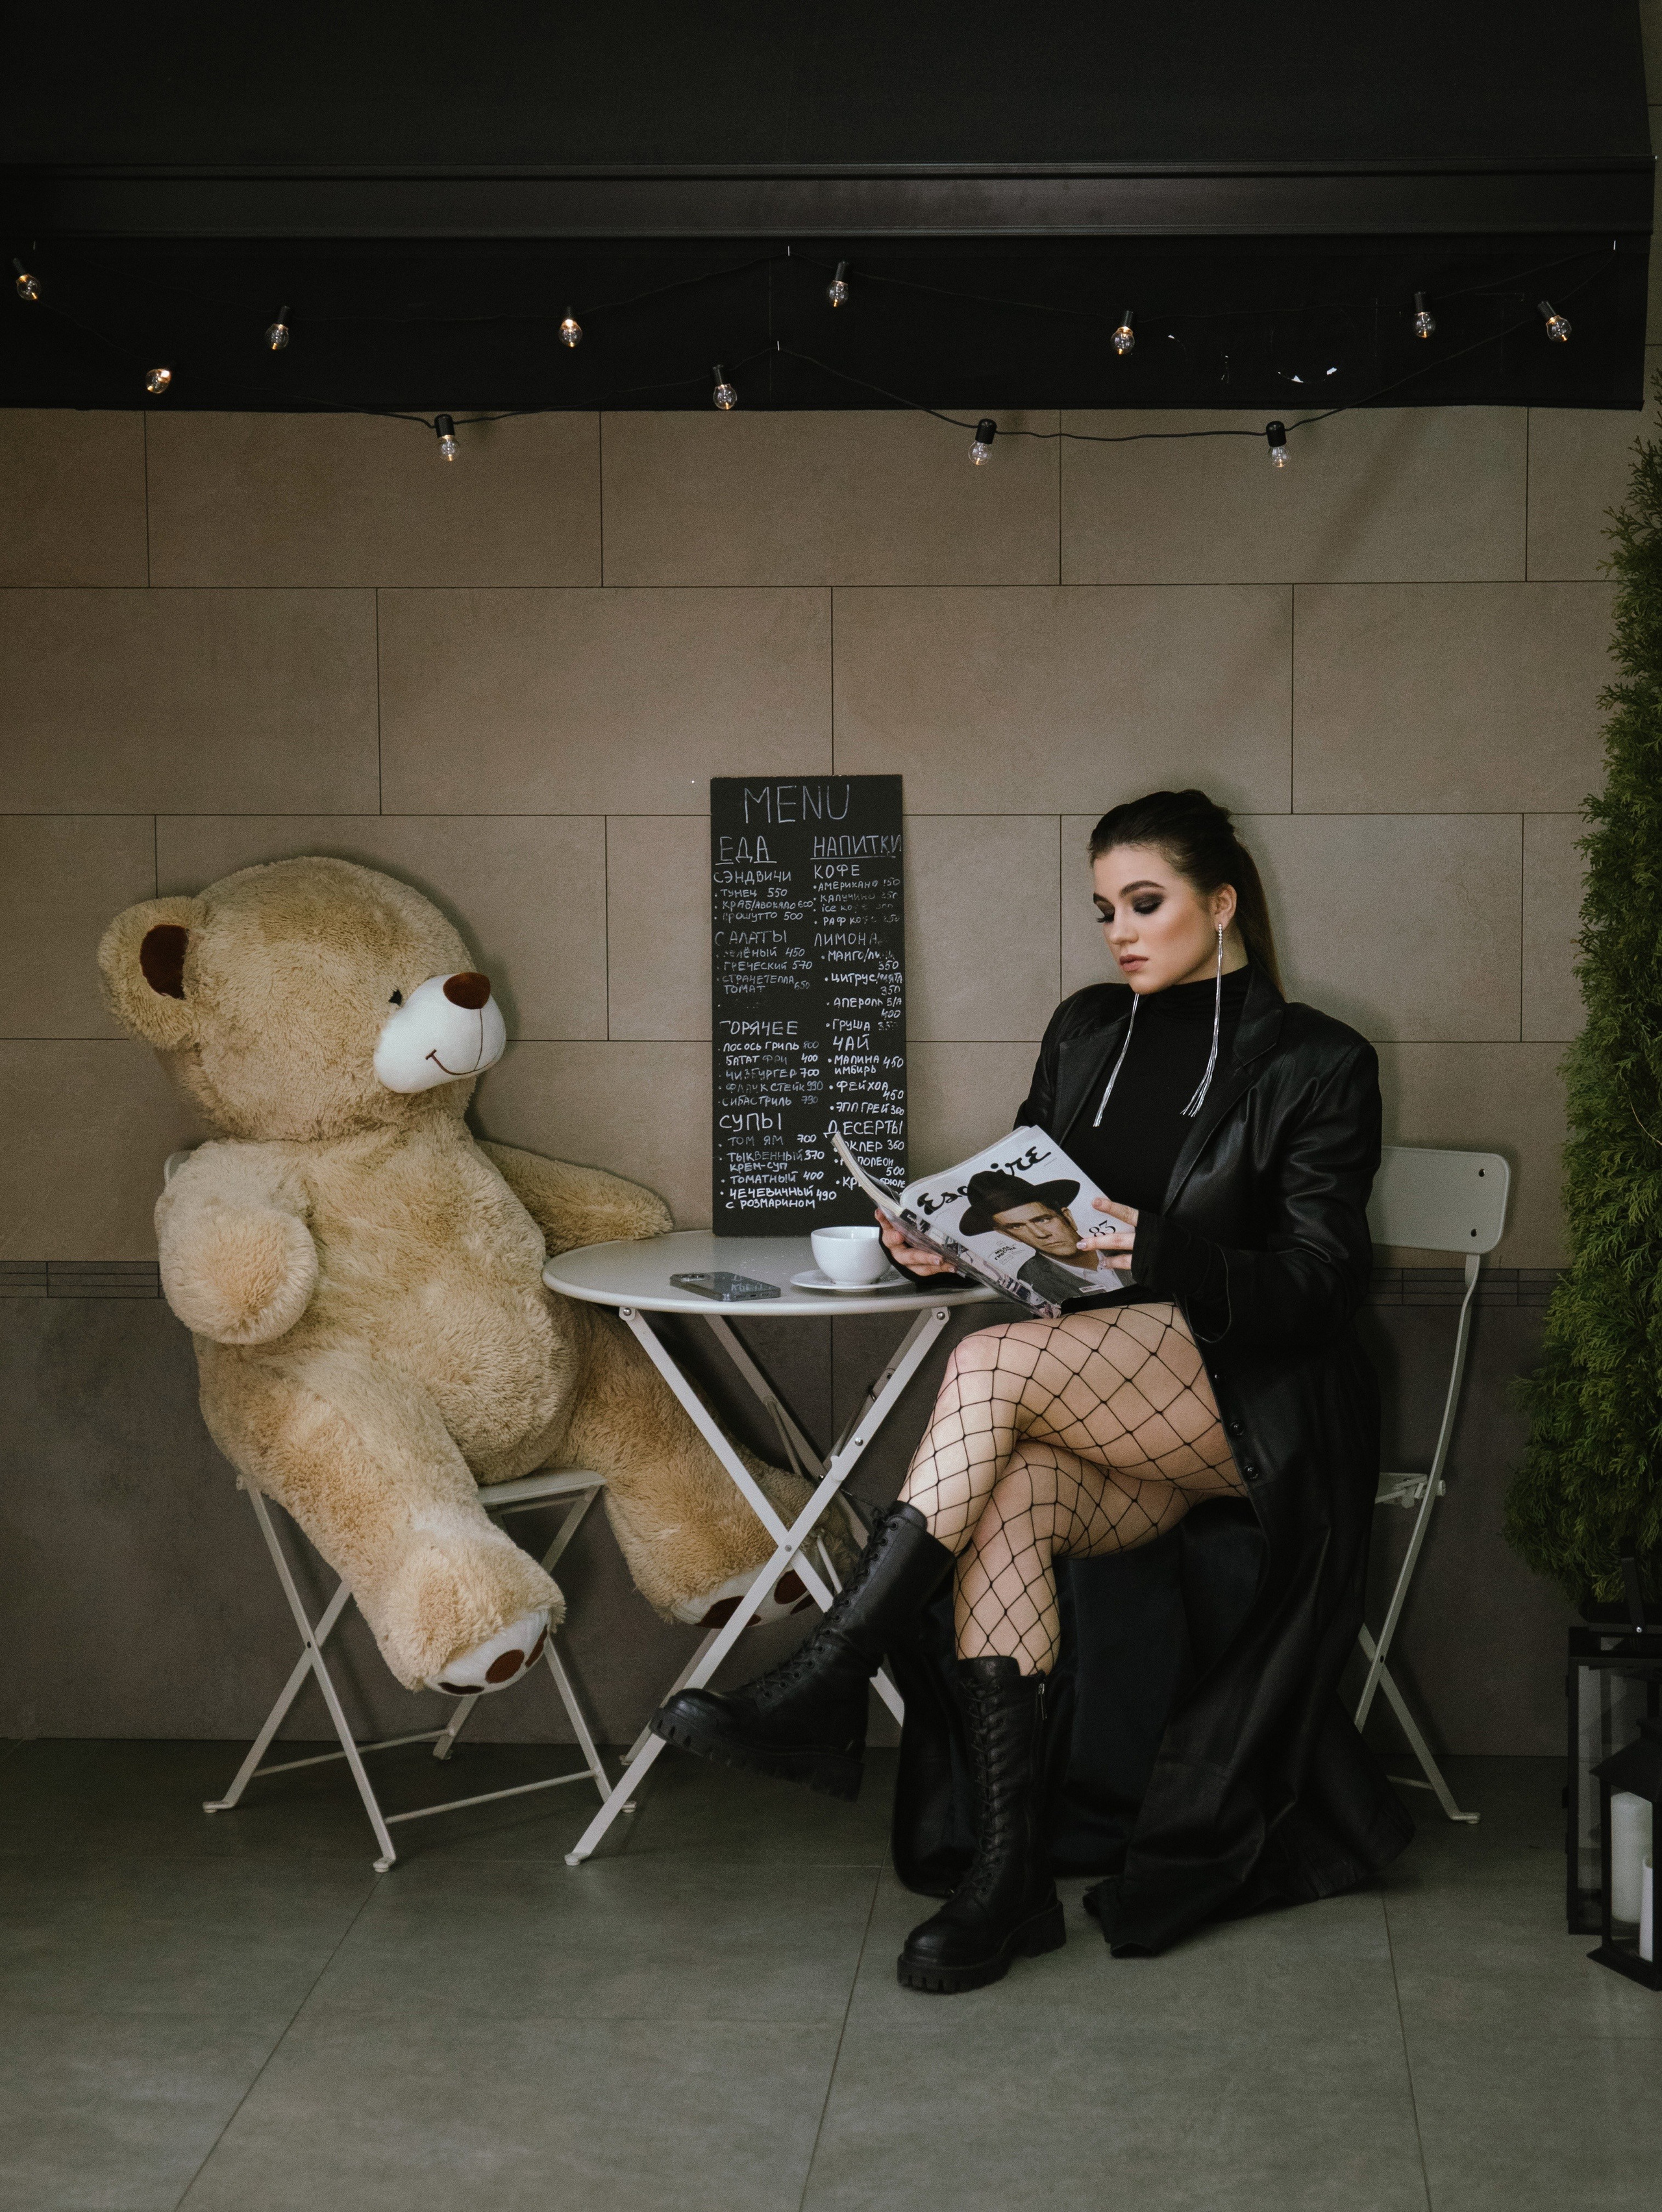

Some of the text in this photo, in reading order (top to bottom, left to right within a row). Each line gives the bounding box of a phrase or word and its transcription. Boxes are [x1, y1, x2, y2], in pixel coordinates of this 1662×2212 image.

[745, 784, 850, 824] MENU
[719, 835, 769, 864] ЕДА
[813, 834, 902, 857] НАПИТКИ
[713, 870, 791, 885] СЭНДВИЧИ
[814, 864, 860, 879] КОФЕ
[818, 880, 878, 891] АМЕРИКАНО
[720, 888, 788, 898] ТУНЕЦ 550
[722, 899, 796, 912] КРАБ/АВОКАДО
[784, 912, 803, 921] 500
[823, 916, 846, 926] РАФ
[715, 930, 787, 946] САЛАТЫ
[814, 932, 883, 947] ЛИМОНА
[723, 947, 805, 958] ЕЛЁНЫЙ 450
[724, 960, 813, 972] ГРЕЧЕСКИЙ 570
[878, 960, 899, 971] 350
[724, 980, 810, 995] ТОМАТ 650
[881, 1008, 901, 1020] 400
[832, 1019, 898, 1032] ГРУША 35
[723, 1043, 762, 1052] ЛОСОСЬ
[765, 1041, 799, 1051] ГРИЛЬ
[833, 1034, 870, 1051] ЧАЙ
[726, 1055, 760, 1066] БАТАТ
[801, 1053, 818, 1063] 400
[834, 1054, 904, 1069] МАЛИНА 450
[800, 1067, 820, 1078] 700
[834, 1065, 876, 1076] ИМБИРЬ
[770, 1082, 804, 1091] СТЕЙК
[806, 1080, 823, 1091] 990
[836, 1080, 888, 1093] ФЕЙХОА
[722, 1095, 758, 1106] СИБАС
[800, 1095, 818, 1104] 790
[883, 1089, 904, 1100] 450
[861, 1102, 890, 1114] ГРЕЙ
[891, 1104, 904, 1115] 300
[719, 1112, 782, 1132] СУПЫ
[823, 1120, 903, 1138] ДЕСЕРТЫ
[728, 1134, 817, 1146] ТОМ ЯМ 700
[887, 1139, 904, 1150] 360
[726, 1149, 825, 1162] ТЫКВЕННЫЙ 370
[840, 1156, 894, 1167] ПОЛЕОН
[730, 1162, 788, 1174] КРЕМ-СУП
[886, 1166, 905, 1176] 500
[730, 1171, 824, 1185] ТОМАТНЫЙ 400
[730, 1185, 837, 1201] ЧЕЧЕВИЧНЫЙ 490
[741, 1199, 815, 1210] РОЗМАРИНОМ
